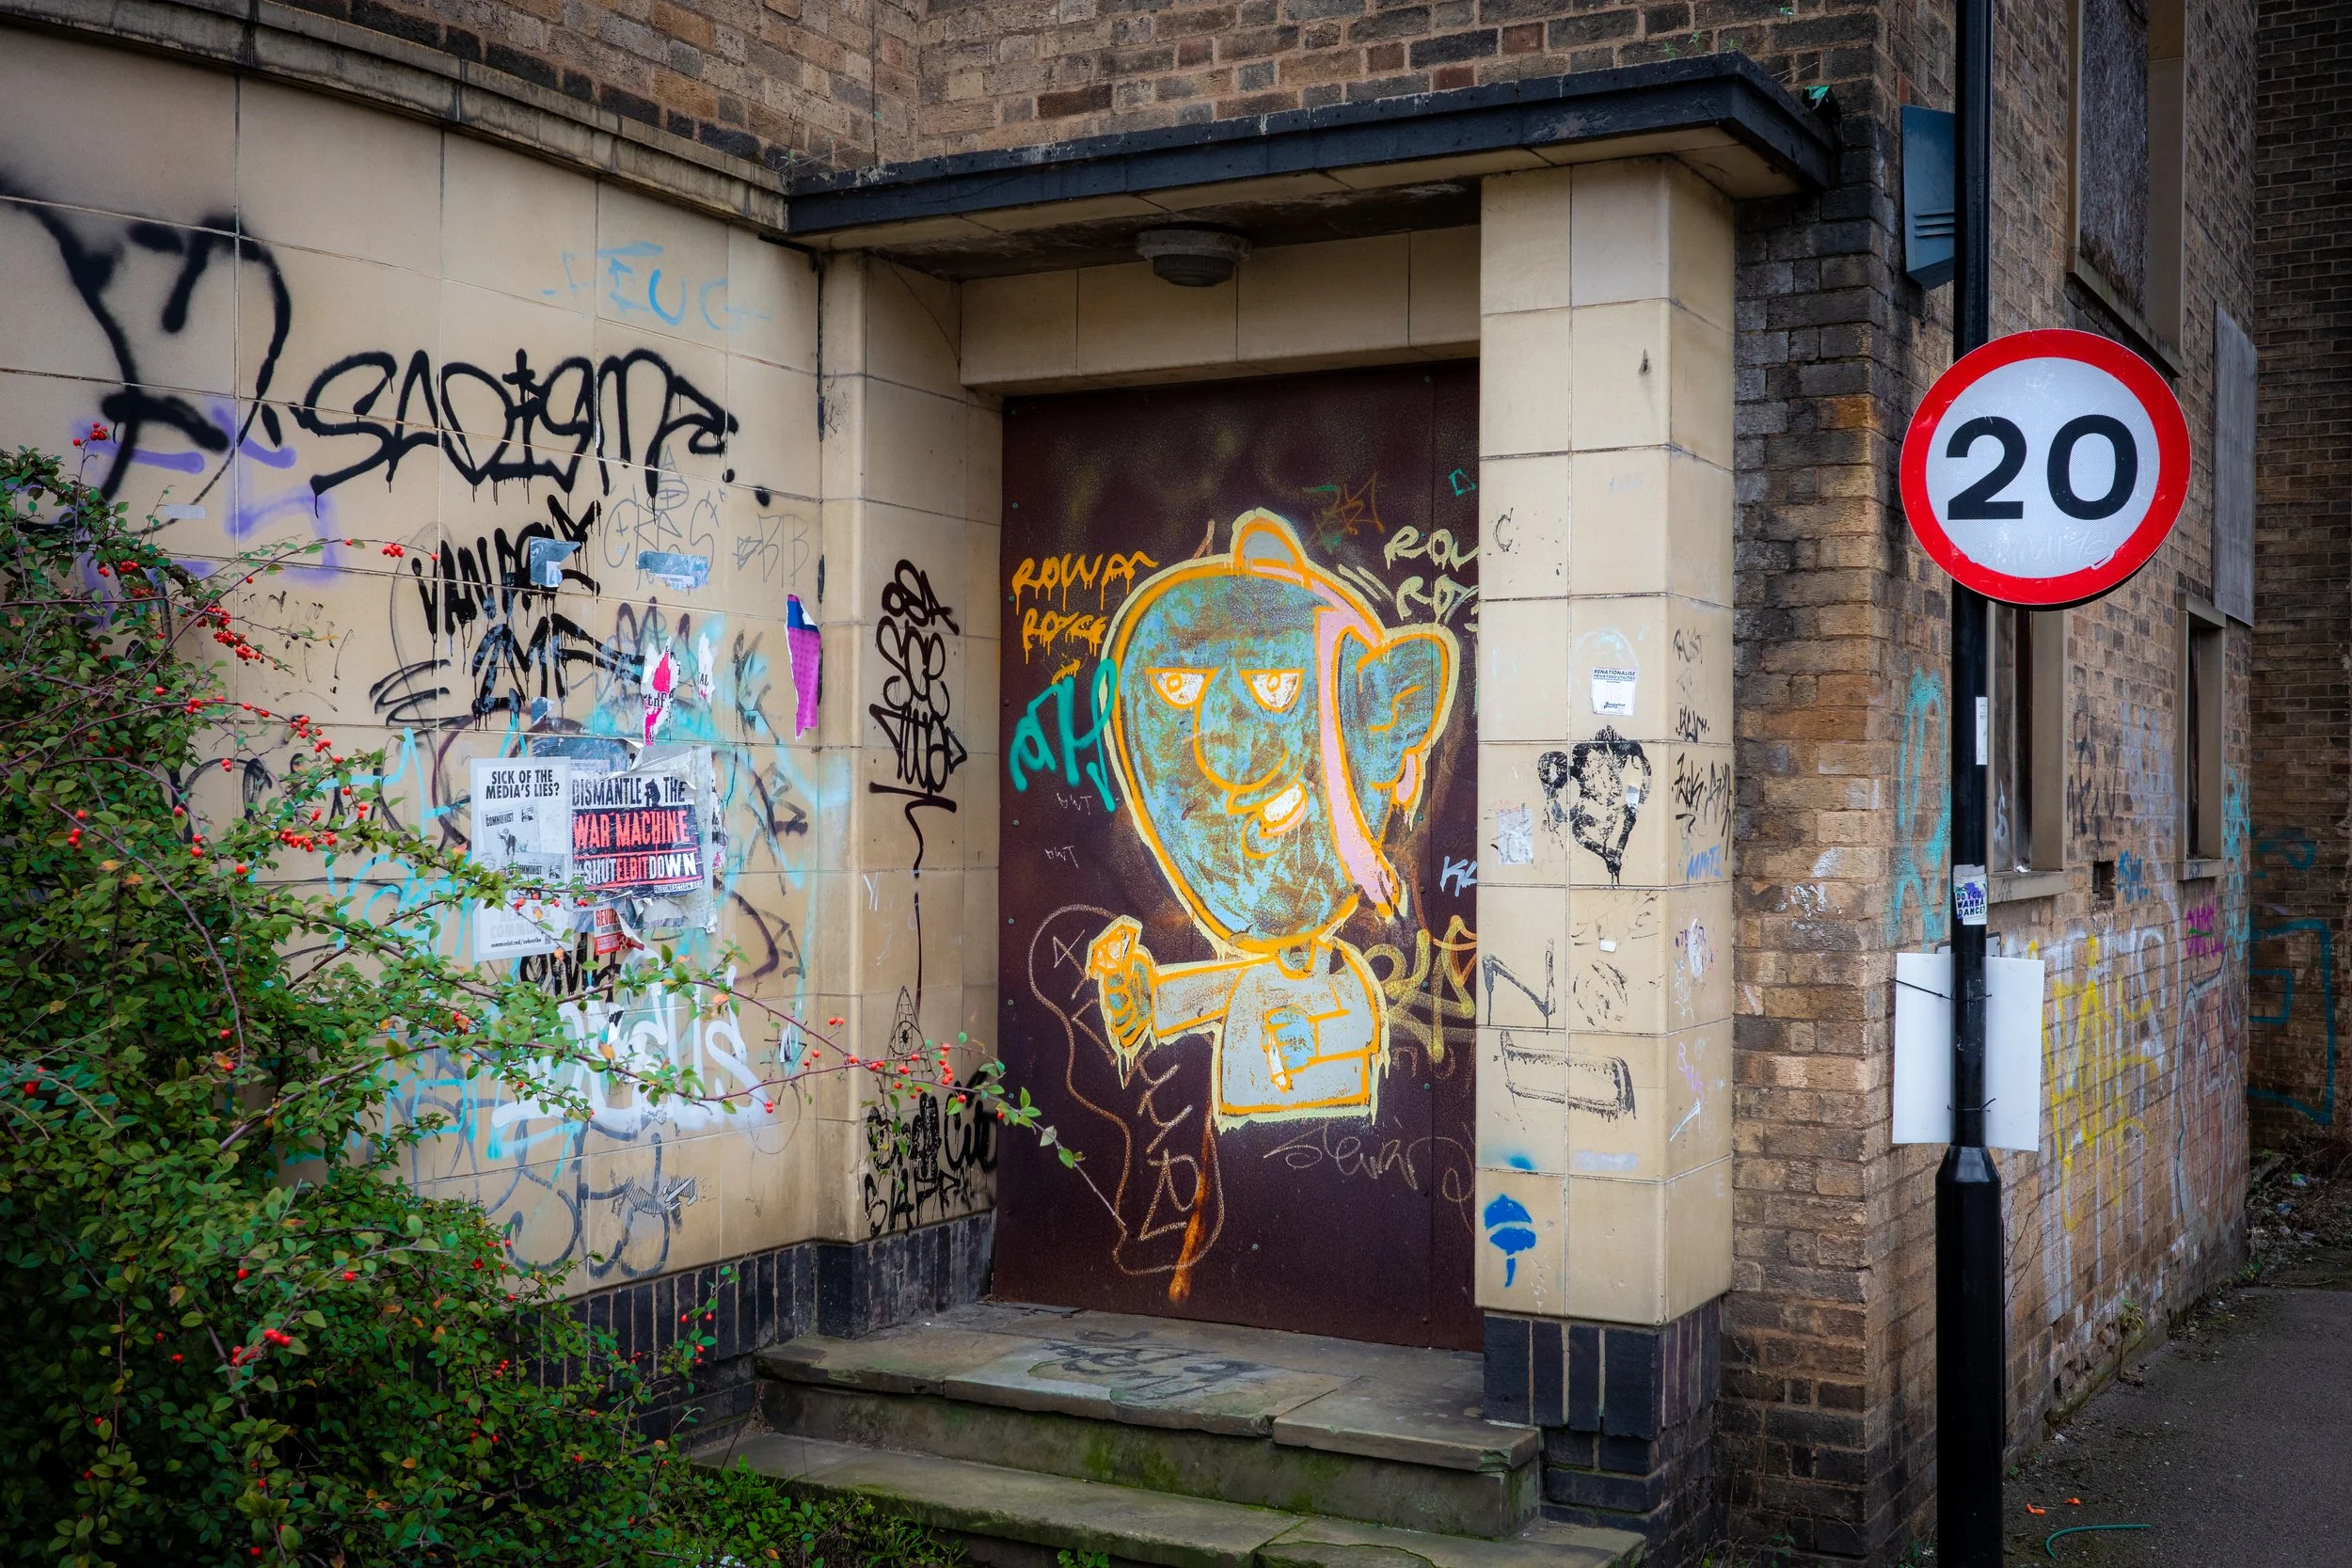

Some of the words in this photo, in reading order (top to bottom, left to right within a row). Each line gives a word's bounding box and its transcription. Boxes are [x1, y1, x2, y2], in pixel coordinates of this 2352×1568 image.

[1946, 414, 2138, 521] 20
[491, 769, 516, 785] SICK
[518, 769, 532, 784] OF
[534, 768, 553, 784] THE
[485, 784, 531, 800] MEDIA'S
[533, 782, 561, 798] LIES?
[571, 777, 643, 807] DISMANTLE
[663, 776, 687, 802] THE
[573, 812, 611, 849] WAR
[615, 810, 691, 847] MACHINE
[1957, 893, 1966, 901] DO
[1966, 890, 1981, 899] YOU
[1957, 898, 1984, 909] WANNA
[490, 937, 542, 948] communist.red/subscribe
